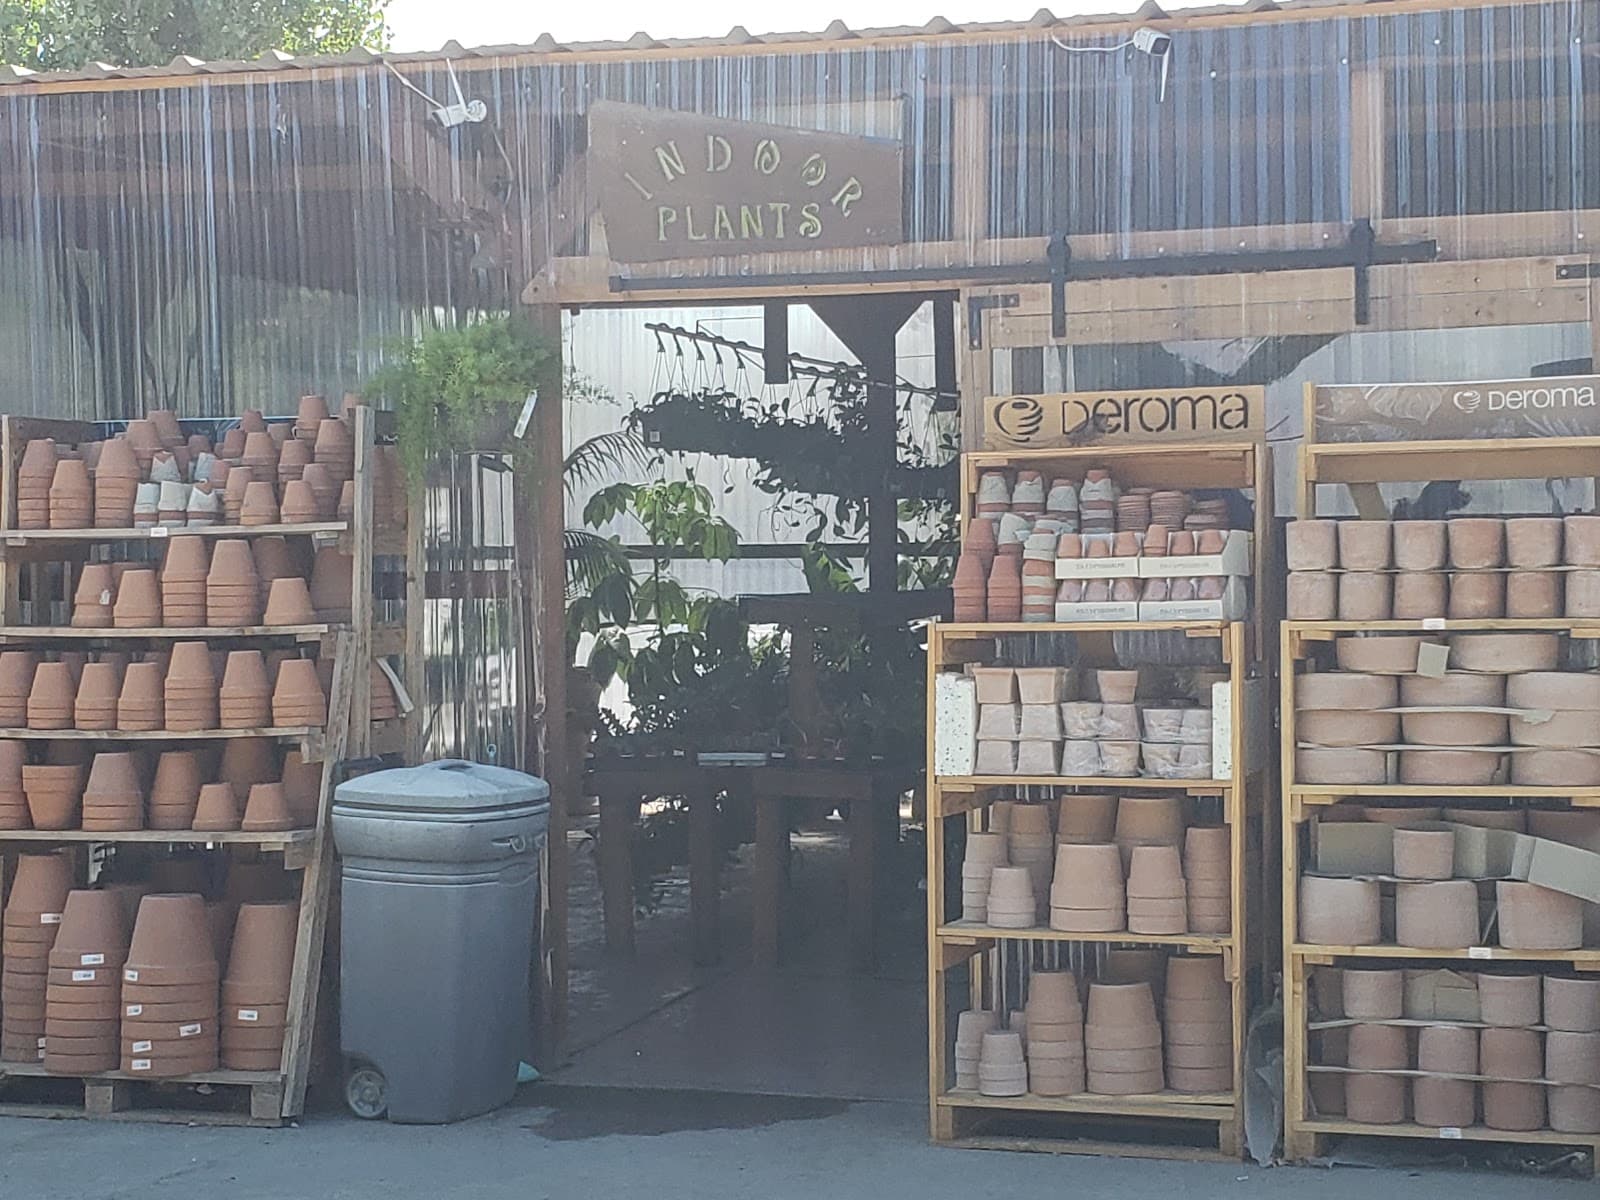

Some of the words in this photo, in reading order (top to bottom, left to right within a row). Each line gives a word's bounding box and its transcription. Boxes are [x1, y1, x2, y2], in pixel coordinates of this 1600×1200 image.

[624, 135, 863, 217] INDOOR
[658, 202, 823, 242] PLANTS
[1061, 393, 1249, 435] Deroma
[1487, 386, 1596, 411] Deroma
